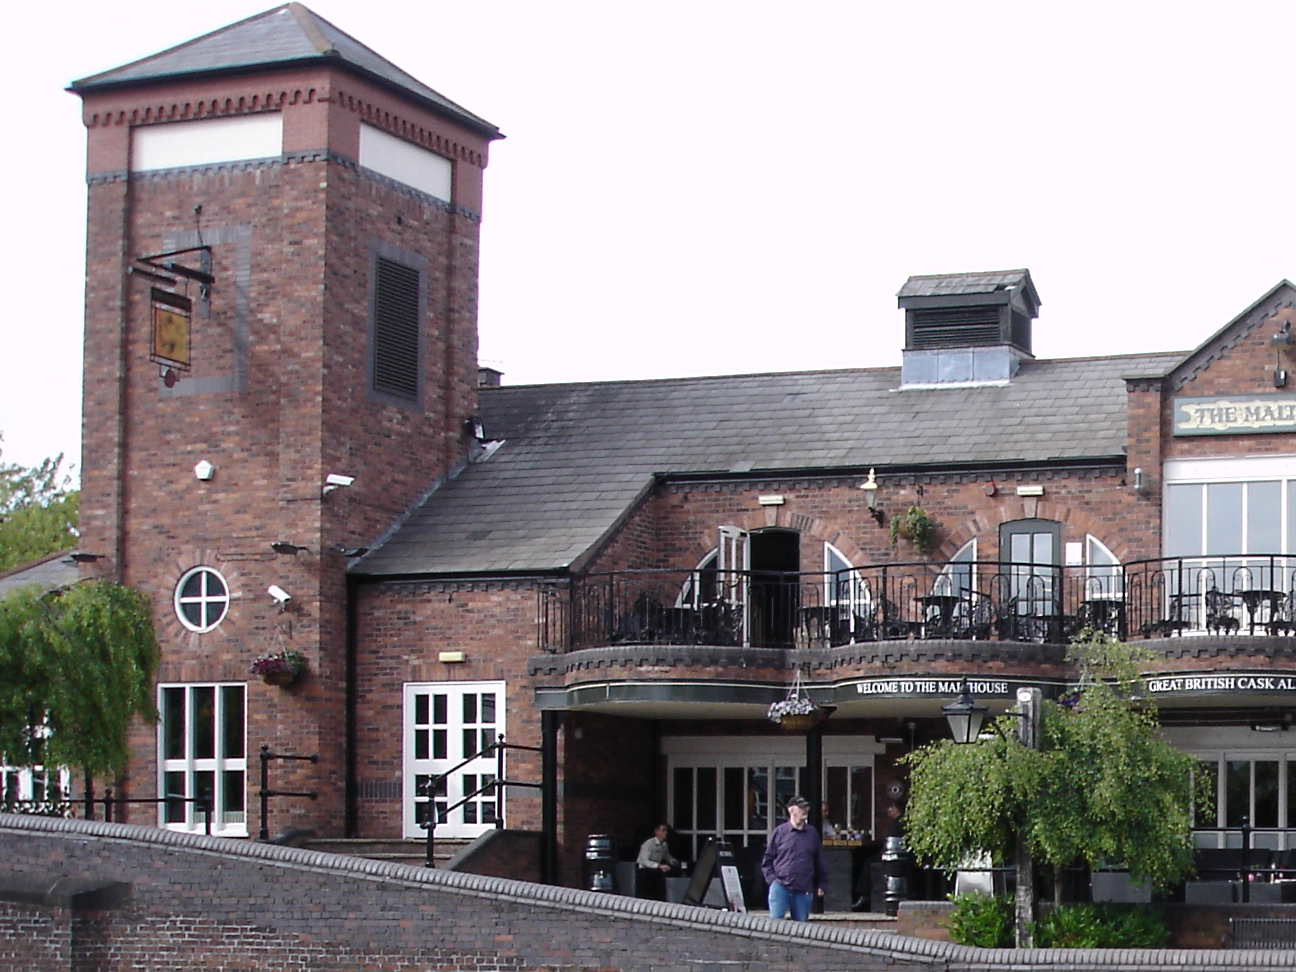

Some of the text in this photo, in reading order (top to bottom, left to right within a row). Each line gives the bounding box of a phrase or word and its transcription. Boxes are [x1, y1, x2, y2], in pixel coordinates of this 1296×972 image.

[1194, 407, 1237, 423] THE
[857, 682, 898, 694] WELCOME
[900, 682, 913, 693] TO
[915, 681, 936, 693] THE
[1149, 678, 1183, 692] GREAT
[1186, 678, 1234, 690] BRITISH
[1238, 678, 1274, 690] CASK
